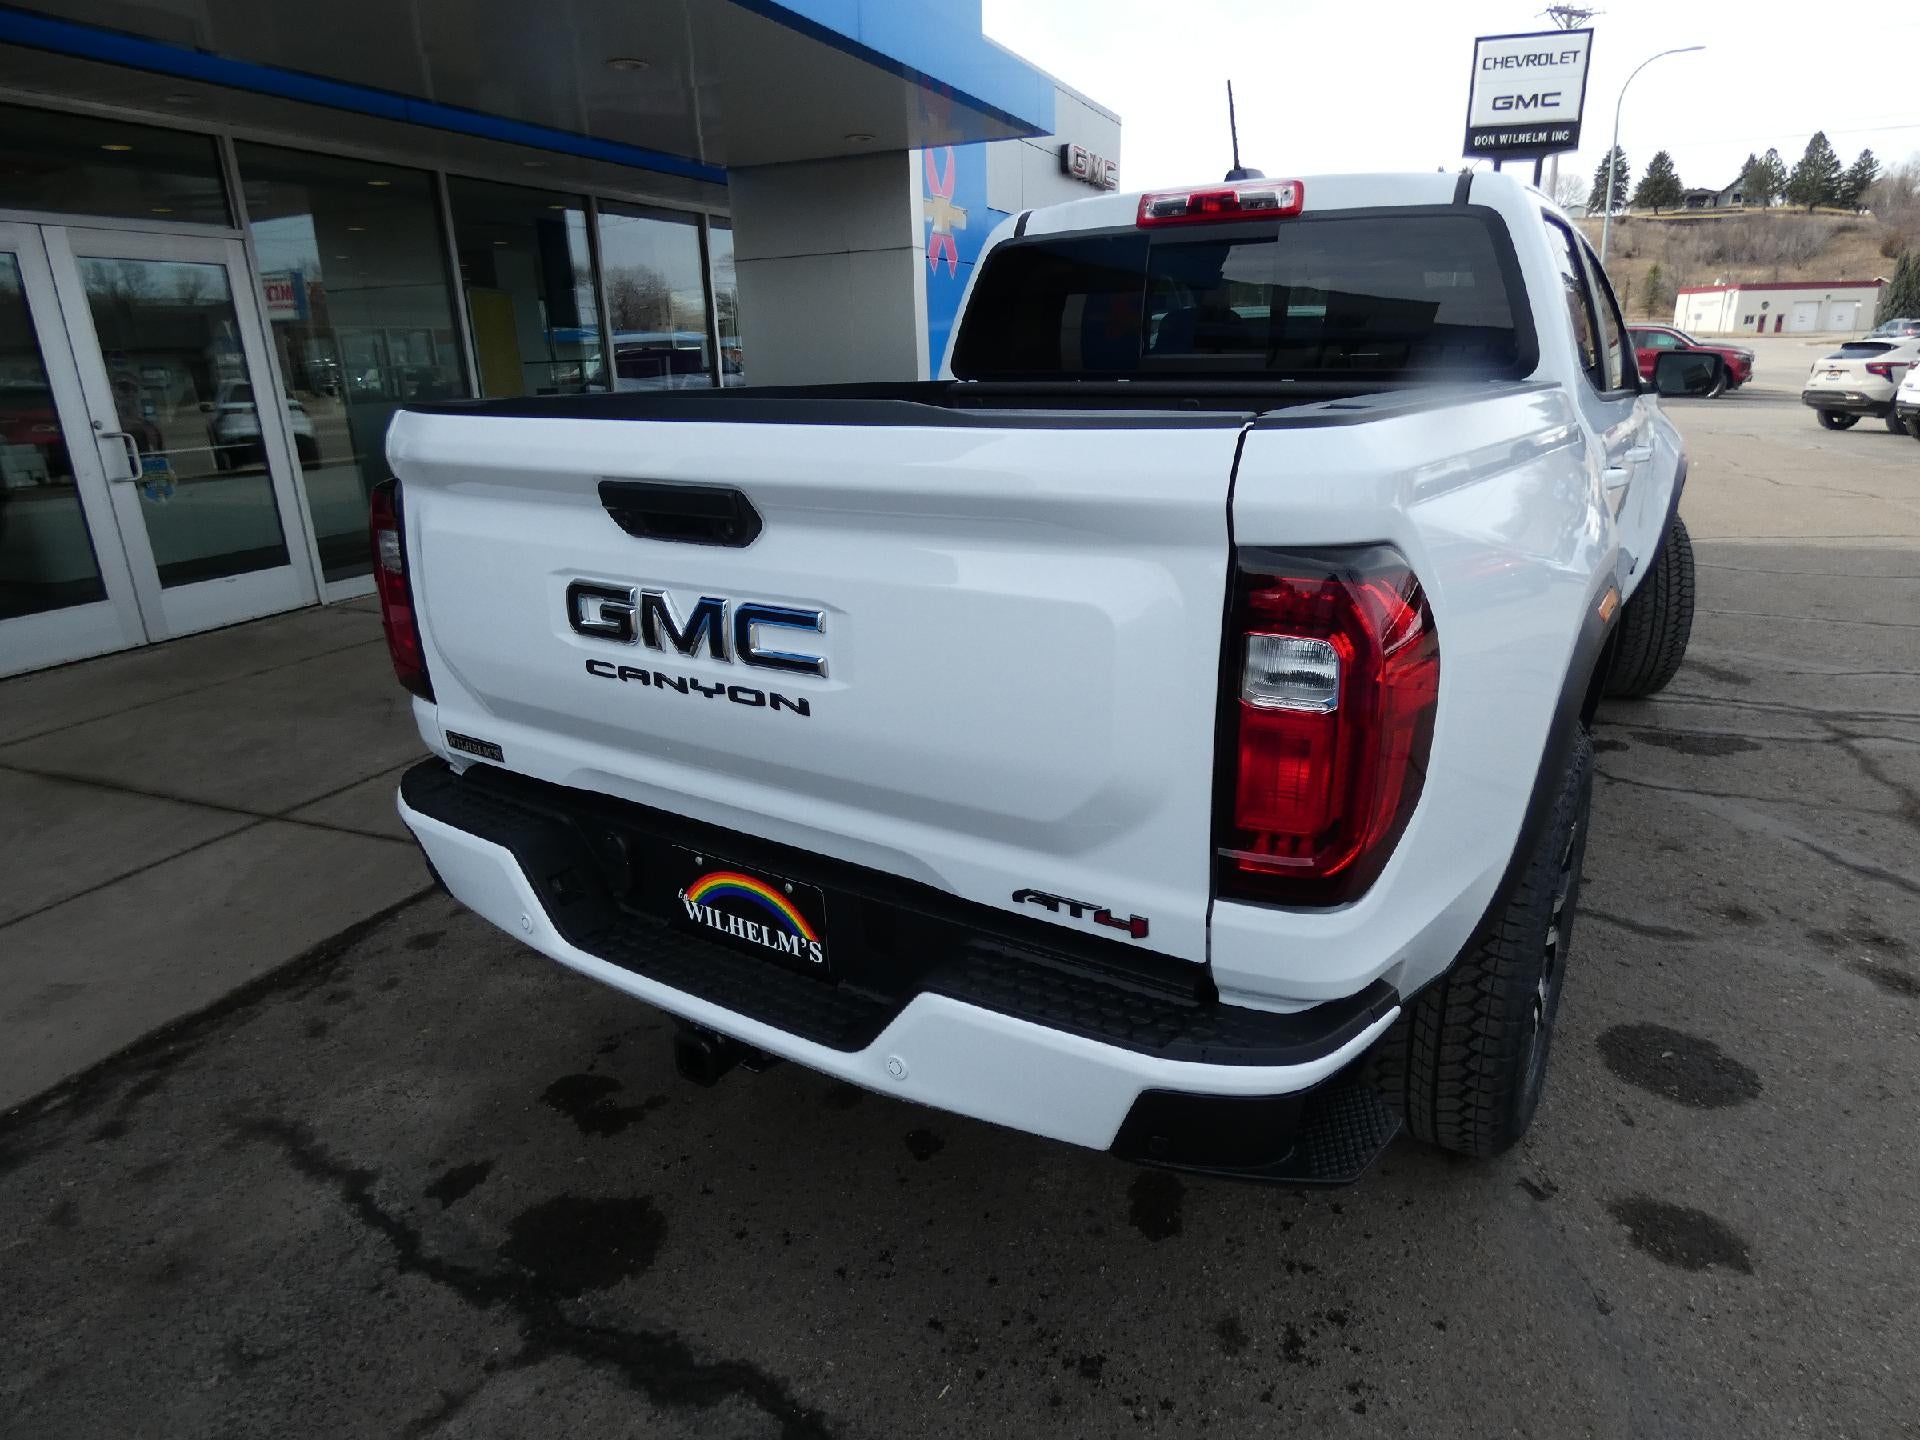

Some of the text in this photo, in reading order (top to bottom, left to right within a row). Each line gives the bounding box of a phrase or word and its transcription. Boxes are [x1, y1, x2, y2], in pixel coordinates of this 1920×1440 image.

[1482, 50, 1581, 71] CHEVROLET
[1491, 92, 1562, 111] GMC
[1474, 130, 1570, 146] DON WILHELM INC
[1063, 143, 1119, 191] GMC
[566, 577, 829, 679] GMC
[585, 658, 811, 717] CANYON
[684, 900, 823, 964] WILHELM'S
[1012, 888, 1149, 940] AT4
